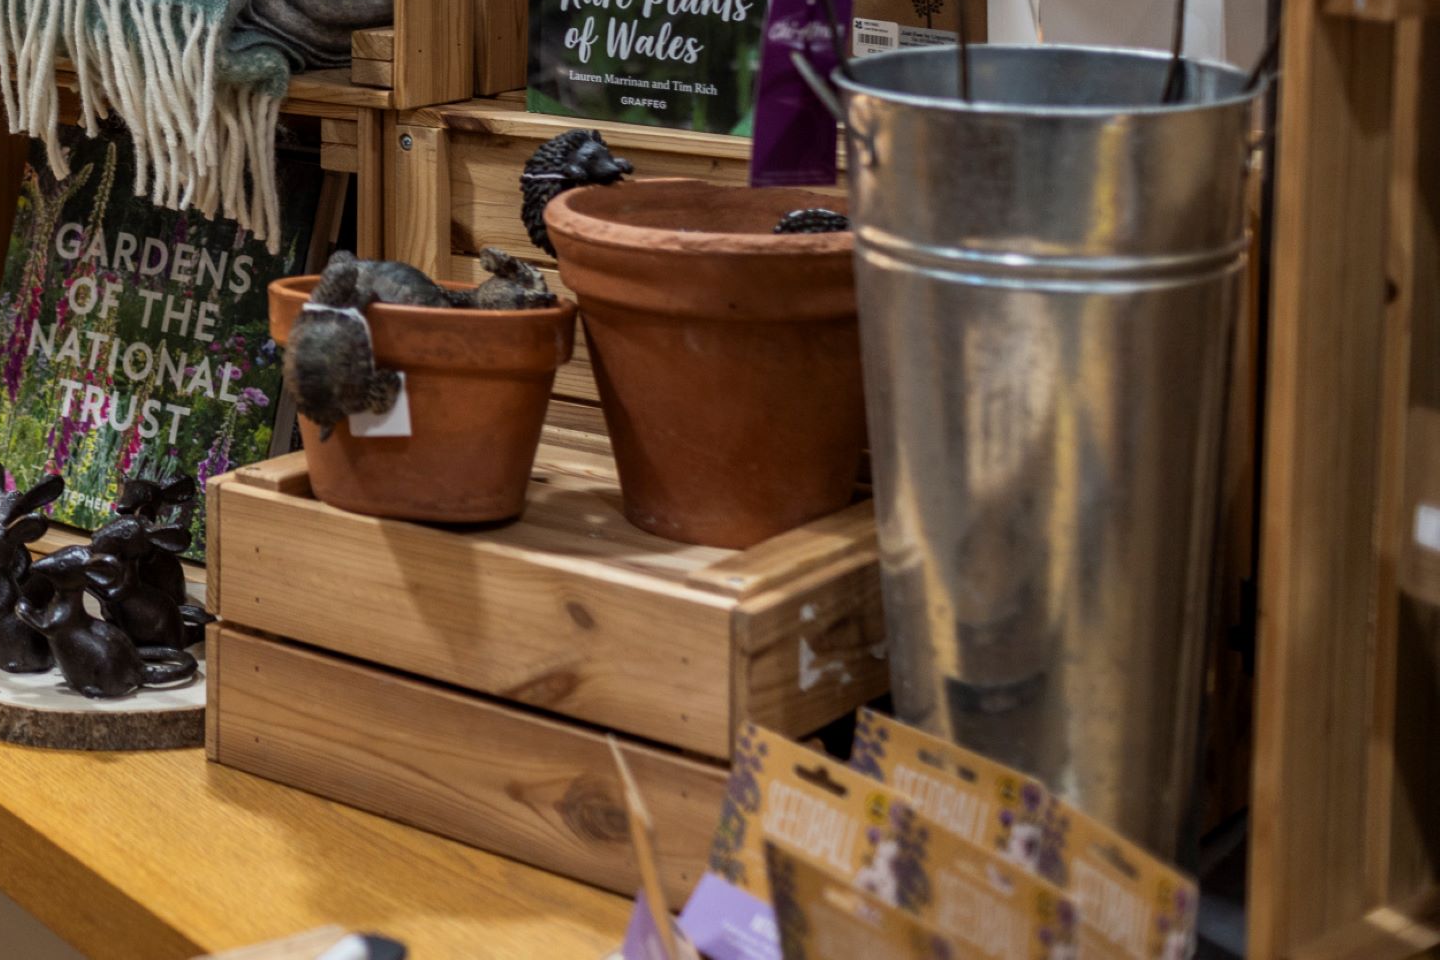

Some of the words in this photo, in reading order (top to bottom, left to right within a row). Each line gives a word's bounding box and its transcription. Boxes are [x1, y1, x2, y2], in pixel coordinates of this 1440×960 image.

[563, 16, 599, 64] of
[606, 16, 704, 65] Wales
[568, 70, 602, 83] Lauren
[604, 74, 650, 89] Marrinan
[651, 80, 671, 91] and
[672, 81, 693, 93] Tim
[694, 83, 719, 96] Rich
[620, 96, 667, 110] GRAFFEG
[55, 222, 253, 295] GARDENS
[67, 277, 123, 320] OF
[138, 288, 220, 343] THE
[27, 322, 238, 403] NATIONAL
[58, 378, 191, 446] TRUST
[63, 488, 112, 513] TEPHEN
